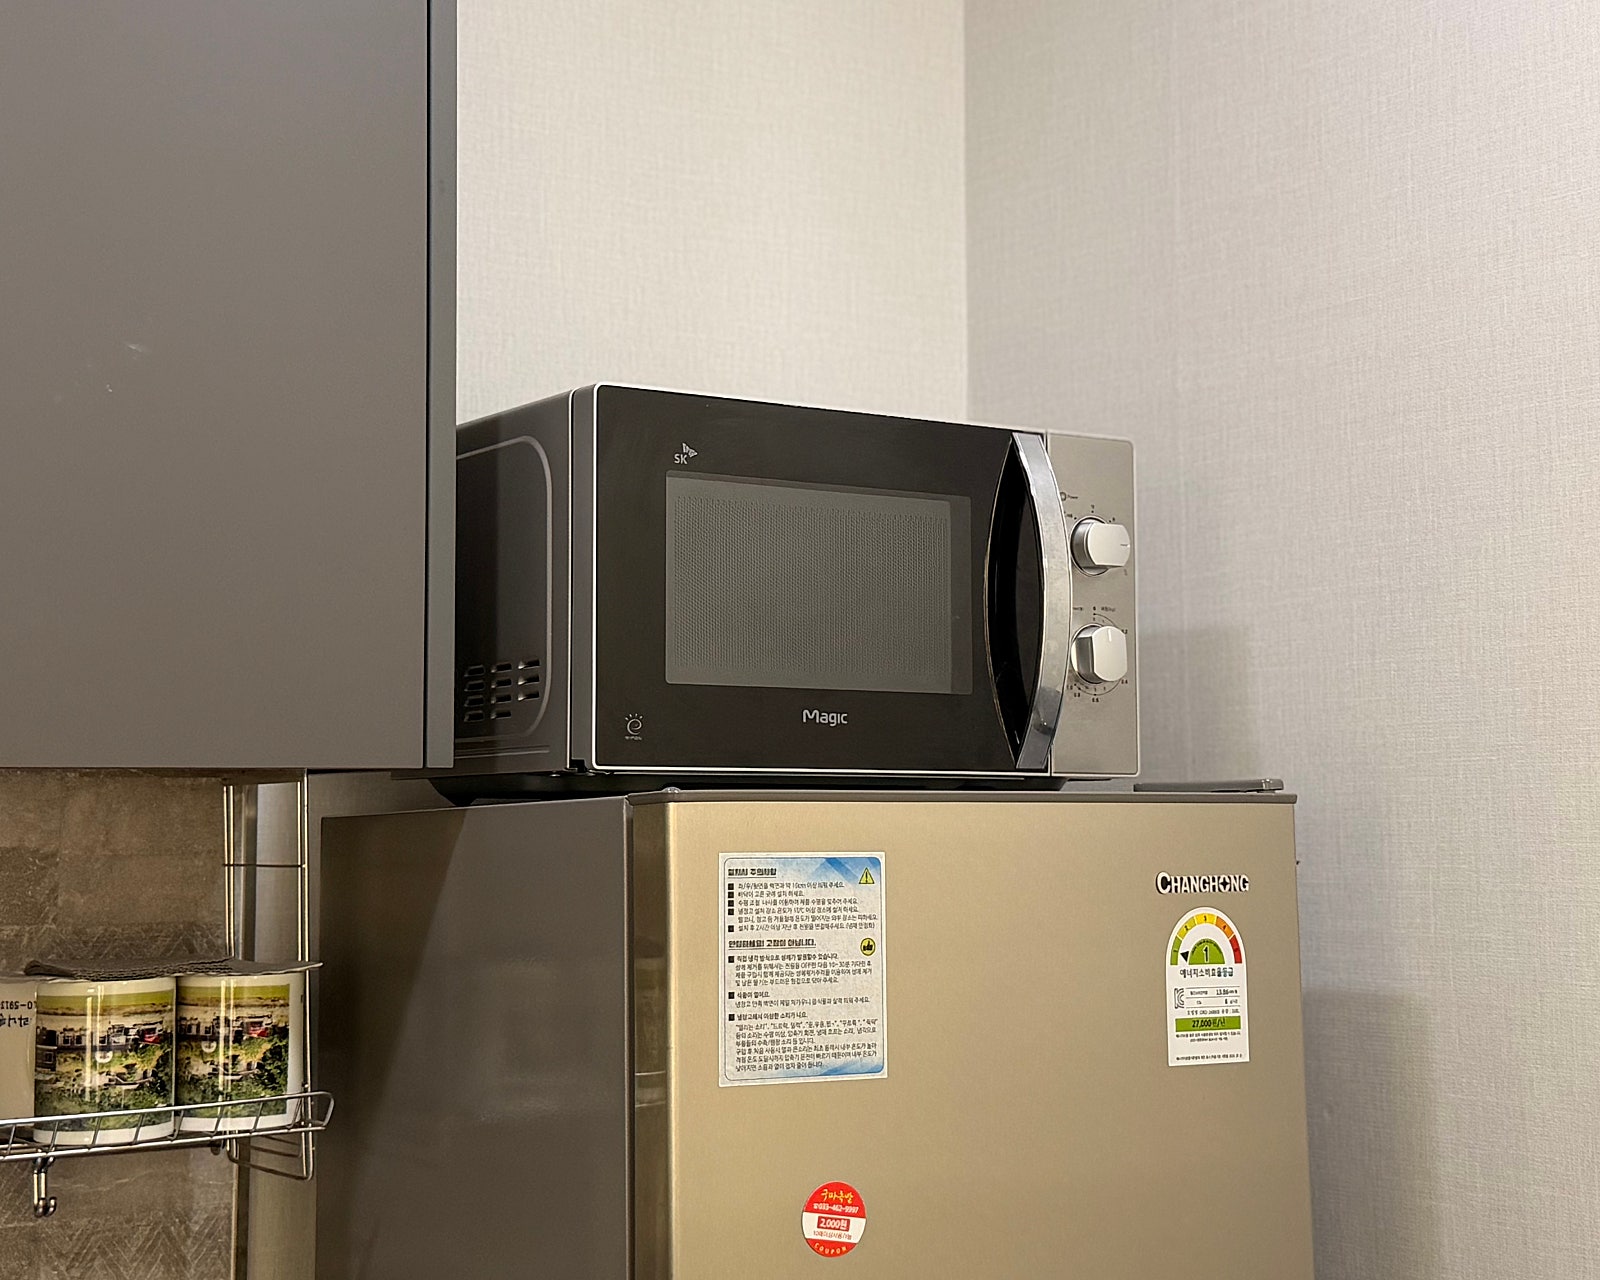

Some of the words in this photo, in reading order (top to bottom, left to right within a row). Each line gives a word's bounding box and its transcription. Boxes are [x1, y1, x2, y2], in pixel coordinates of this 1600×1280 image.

[674, 453, 688, 465] SK
[802, 709, 849, 727] Magic
[1156, 871, 1250, 895] CHANGHONG
[1203, 946, 1209, 963] 1
[1179, 966, 1234, 979] 에너지소비효율등급
